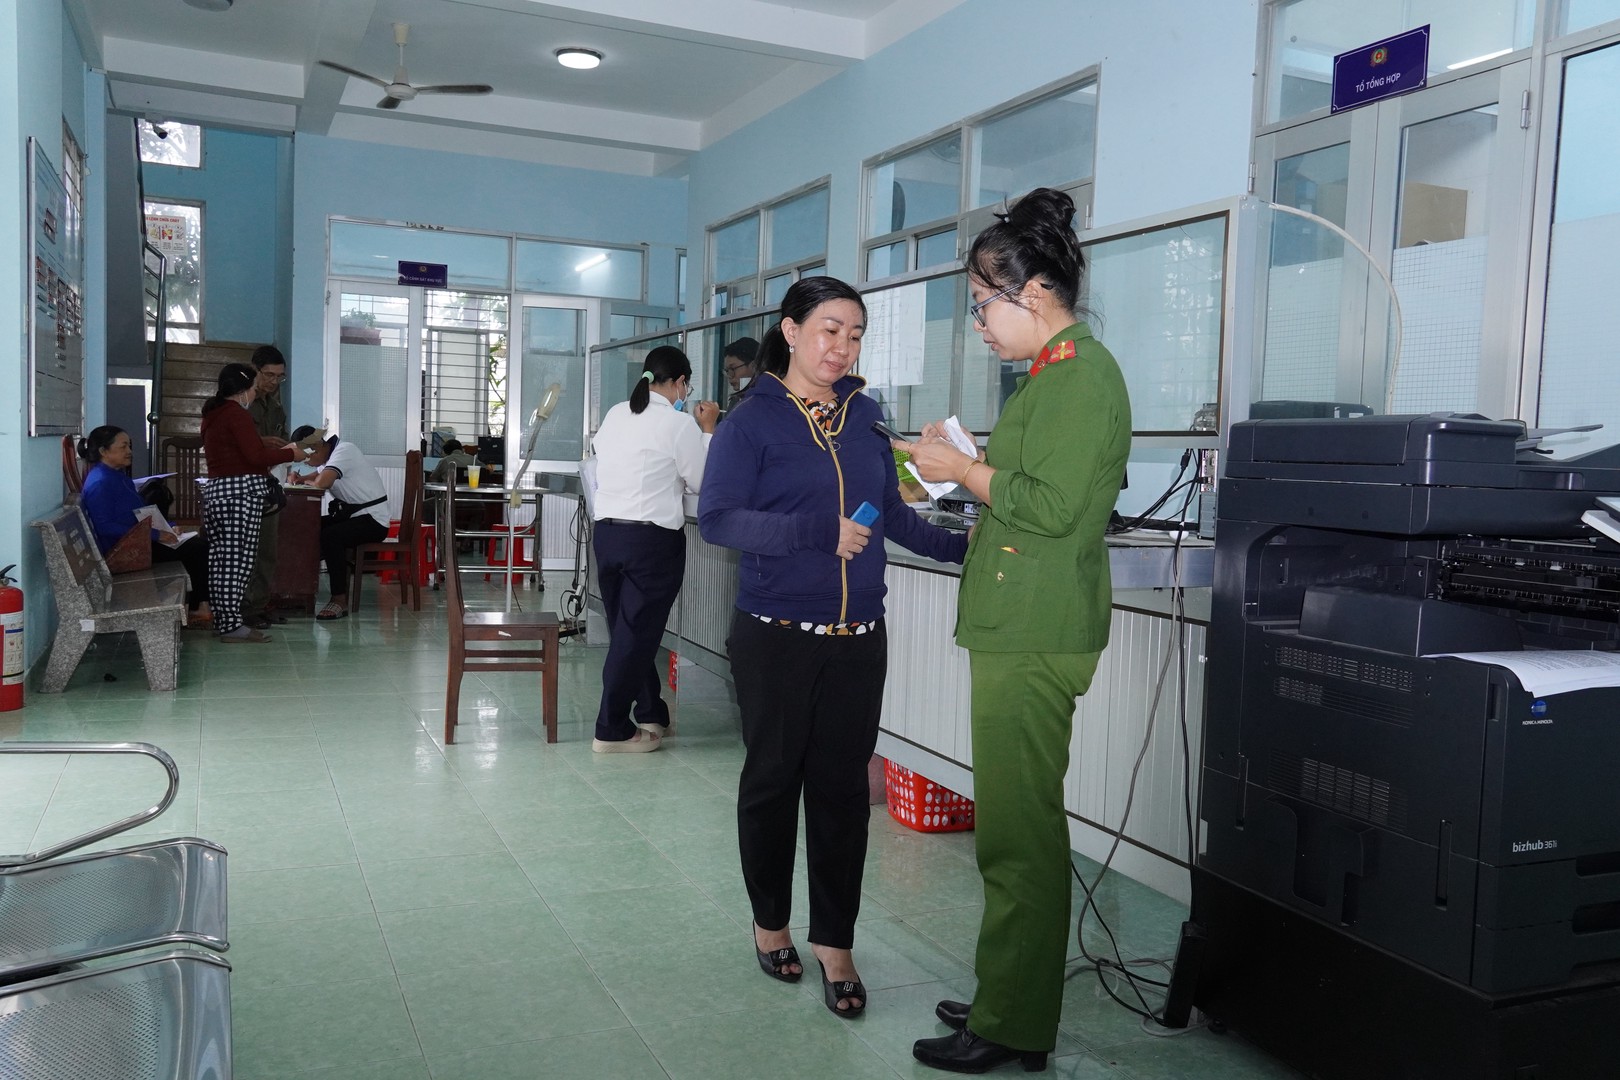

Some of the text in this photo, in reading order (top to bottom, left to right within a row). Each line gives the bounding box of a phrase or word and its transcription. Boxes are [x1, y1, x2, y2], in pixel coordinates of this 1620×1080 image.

[1355, 72, 1401, 93] TỔ TỔNG HỢP
[1512, 839, 1544, 853] bizhub
